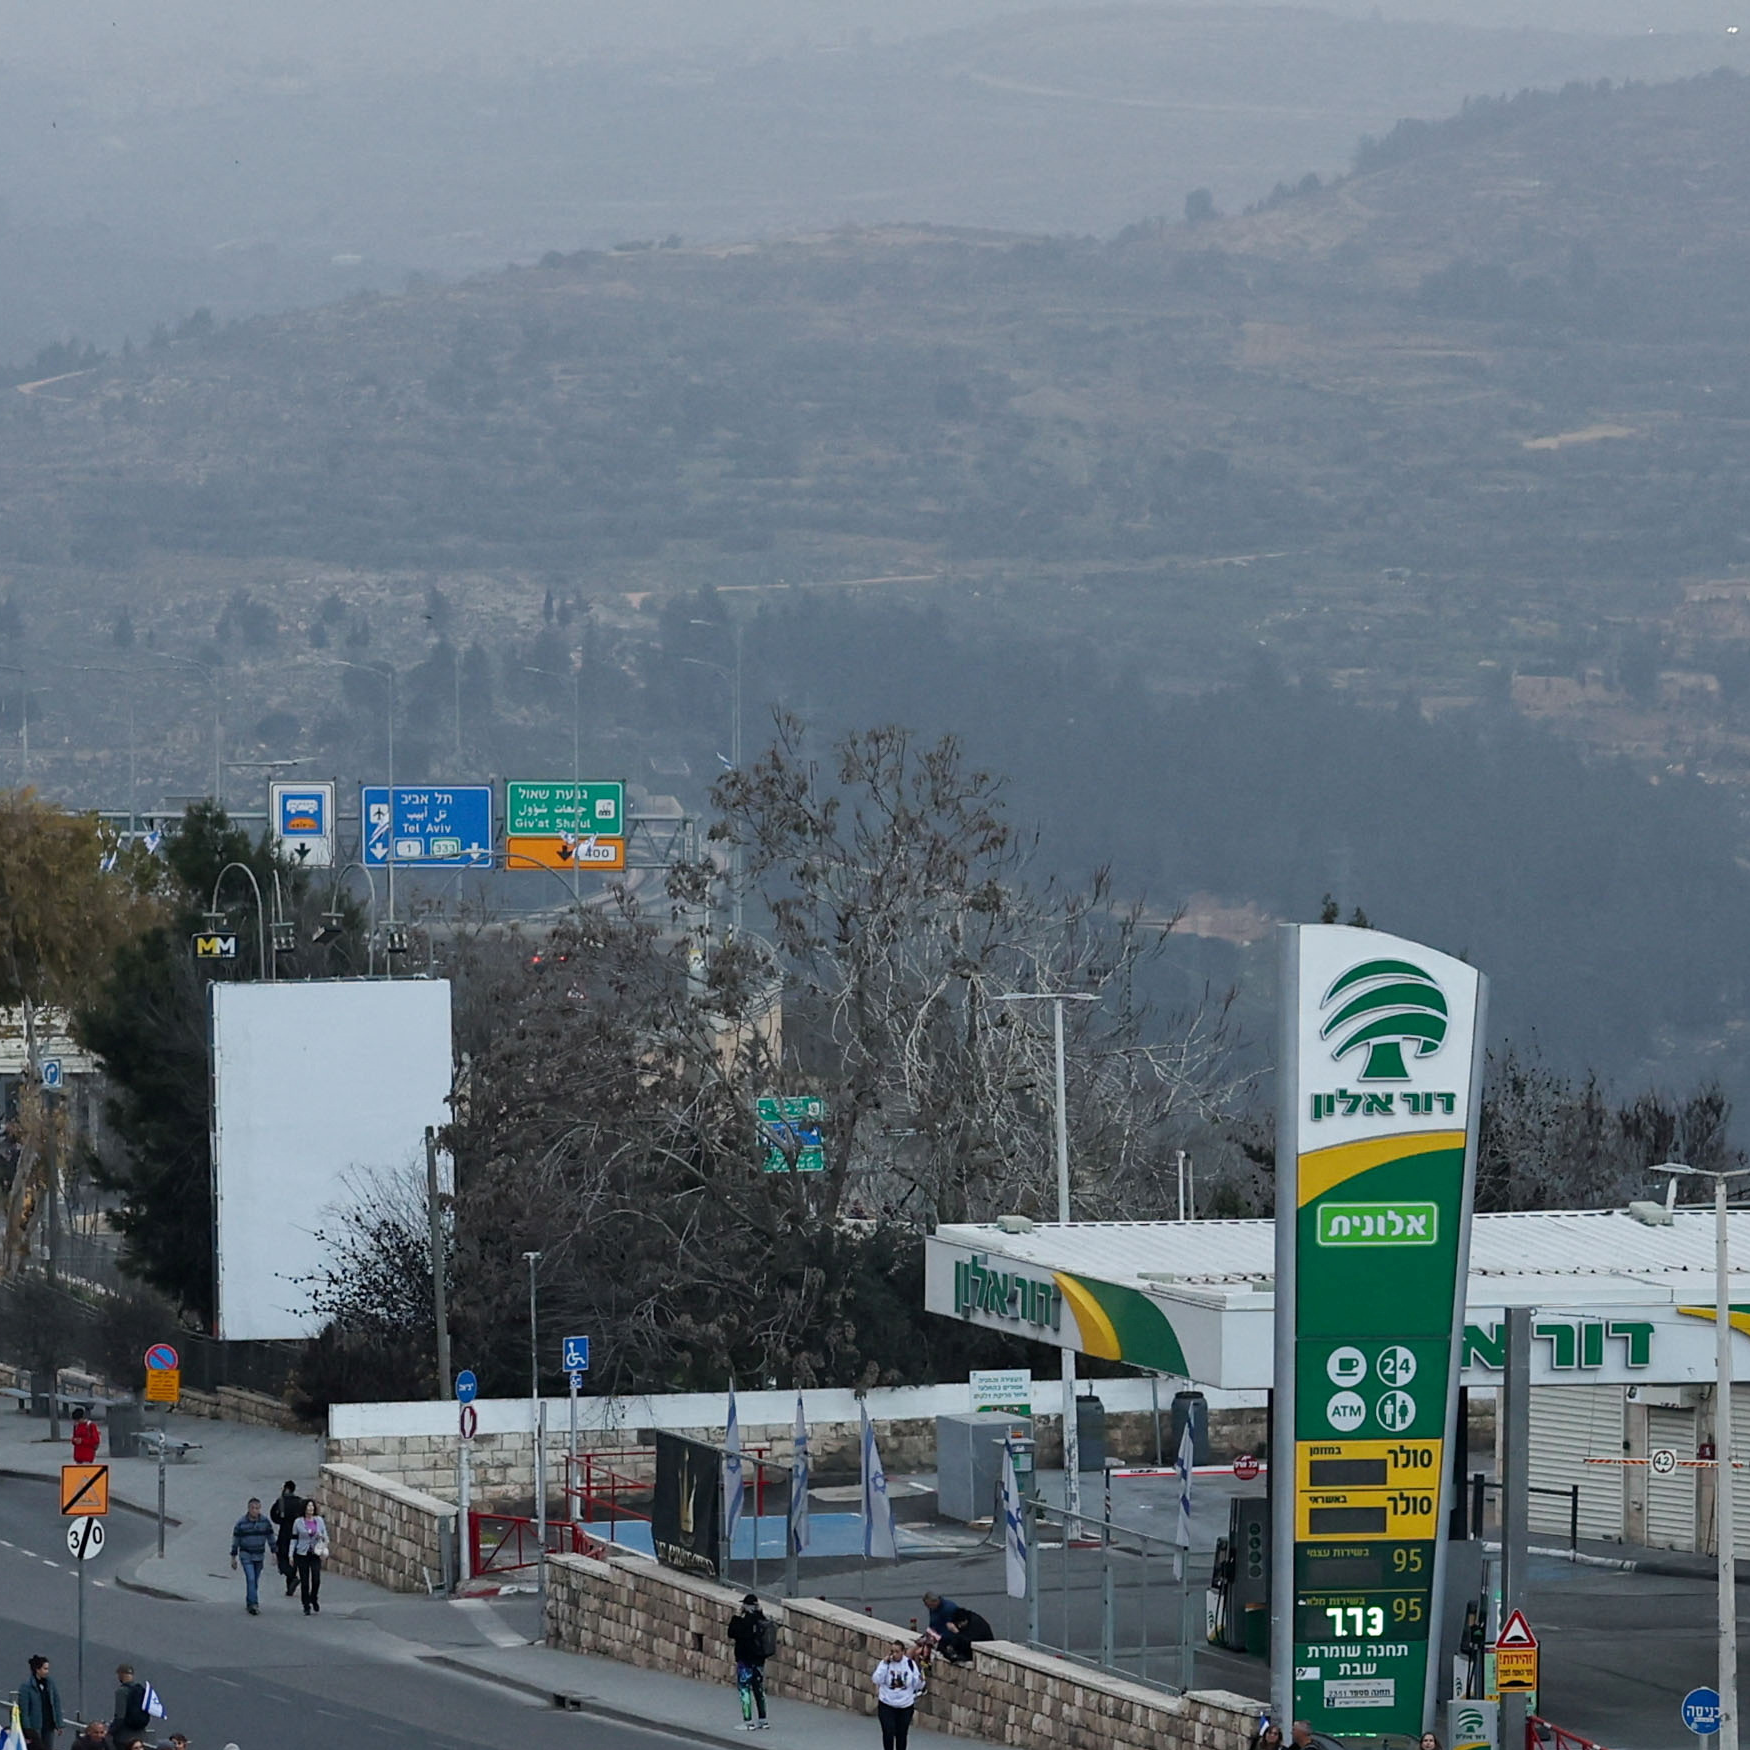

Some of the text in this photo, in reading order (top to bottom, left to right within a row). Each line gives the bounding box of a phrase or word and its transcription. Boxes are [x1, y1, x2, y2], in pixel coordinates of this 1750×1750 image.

[401, 792, 453, 805] תל אביב
[519, 787, 549, 800] שאול
[402, 822, 452, 833] Tel Aviv
[436, 843, 454, 852] 333
[1311, 1088, 1457, 1121] דור אלון
[1328, 1209, 1427, 1237] אלונית
[954, 1254, 1055, 1328] דור אלון
[1533, 1321, 1654, 1370] דור
[1383, 1359, 1411, 1375] 24
[1332, 1405, 1362, 1418] ATM
[1309, 1446, 1432, 1468] סולר במזומן
[1387, 1493, 1432, 1515] סולר
[1392, 1548, 1422, 1573] 95
[1392, 1598, 1422, 1623] 95
[1326, 1607, 1384, 1637] 7.73
[1307, 1644, 1408, 1659] תחנה שומרת
[1339, 1661, 1377, 1676] שבת
